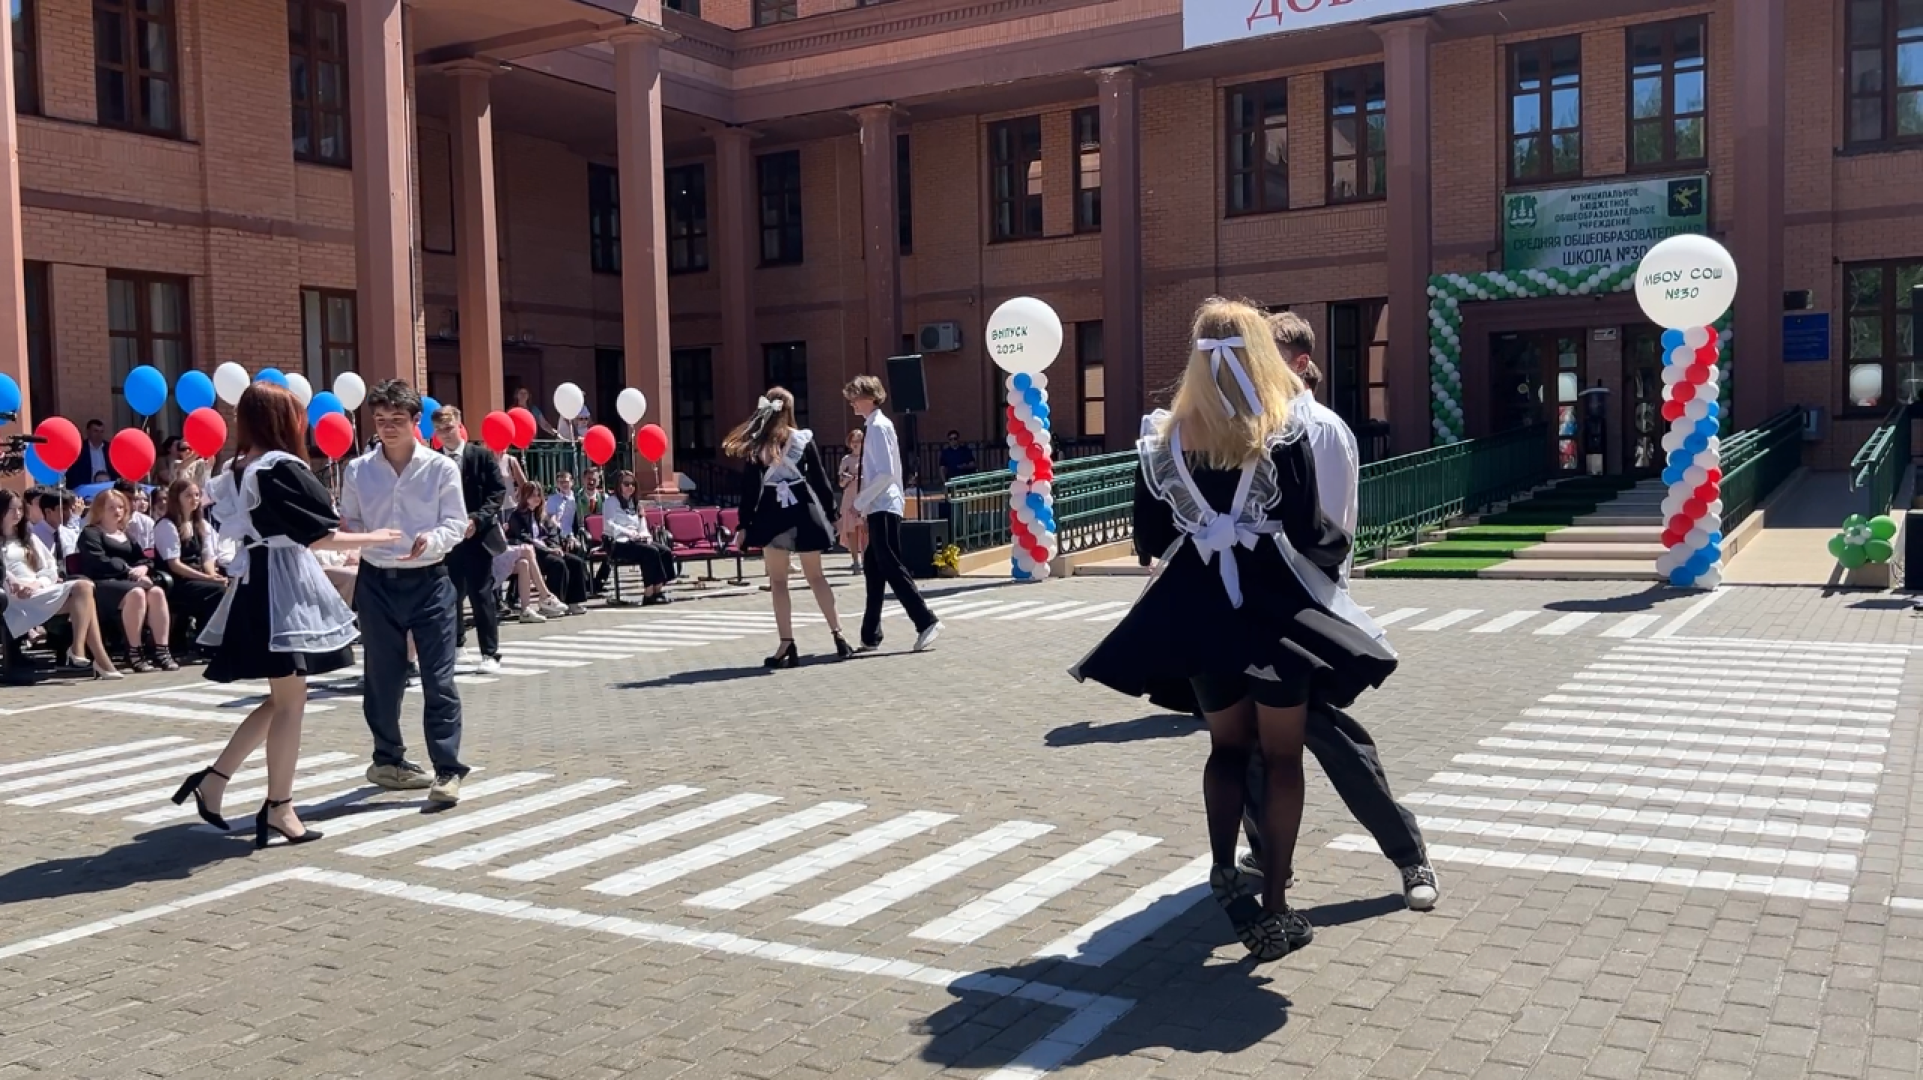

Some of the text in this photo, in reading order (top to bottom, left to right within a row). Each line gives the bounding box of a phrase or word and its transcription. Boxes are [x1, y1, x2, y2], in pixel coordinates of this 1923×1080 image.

[1570, 188, 1639, 202] МУНИЦИПАЛЬНОЕ
[1579, 199, 1630, 211] БЮДЖЕТНОЕ
[1554, 205, 1656, 223] ОБЩЕОБРАЗОВАТЕЛЬНОЕ
[1577, 217, 1632, 230] УЧРЕЖДЕНИЕ
[1513, 236, 1561, 250] СРЕДНЯЯ
[1563, 245, 1648, 266] ШКОЛА №30
[1643, 267, 1723, 287] МБОУ СОШ
[1665, 287, 1699, 300] №30
[991, 326, 1028, 341] ВЫПУСК
[996, 342, 1024, 354] 2024
